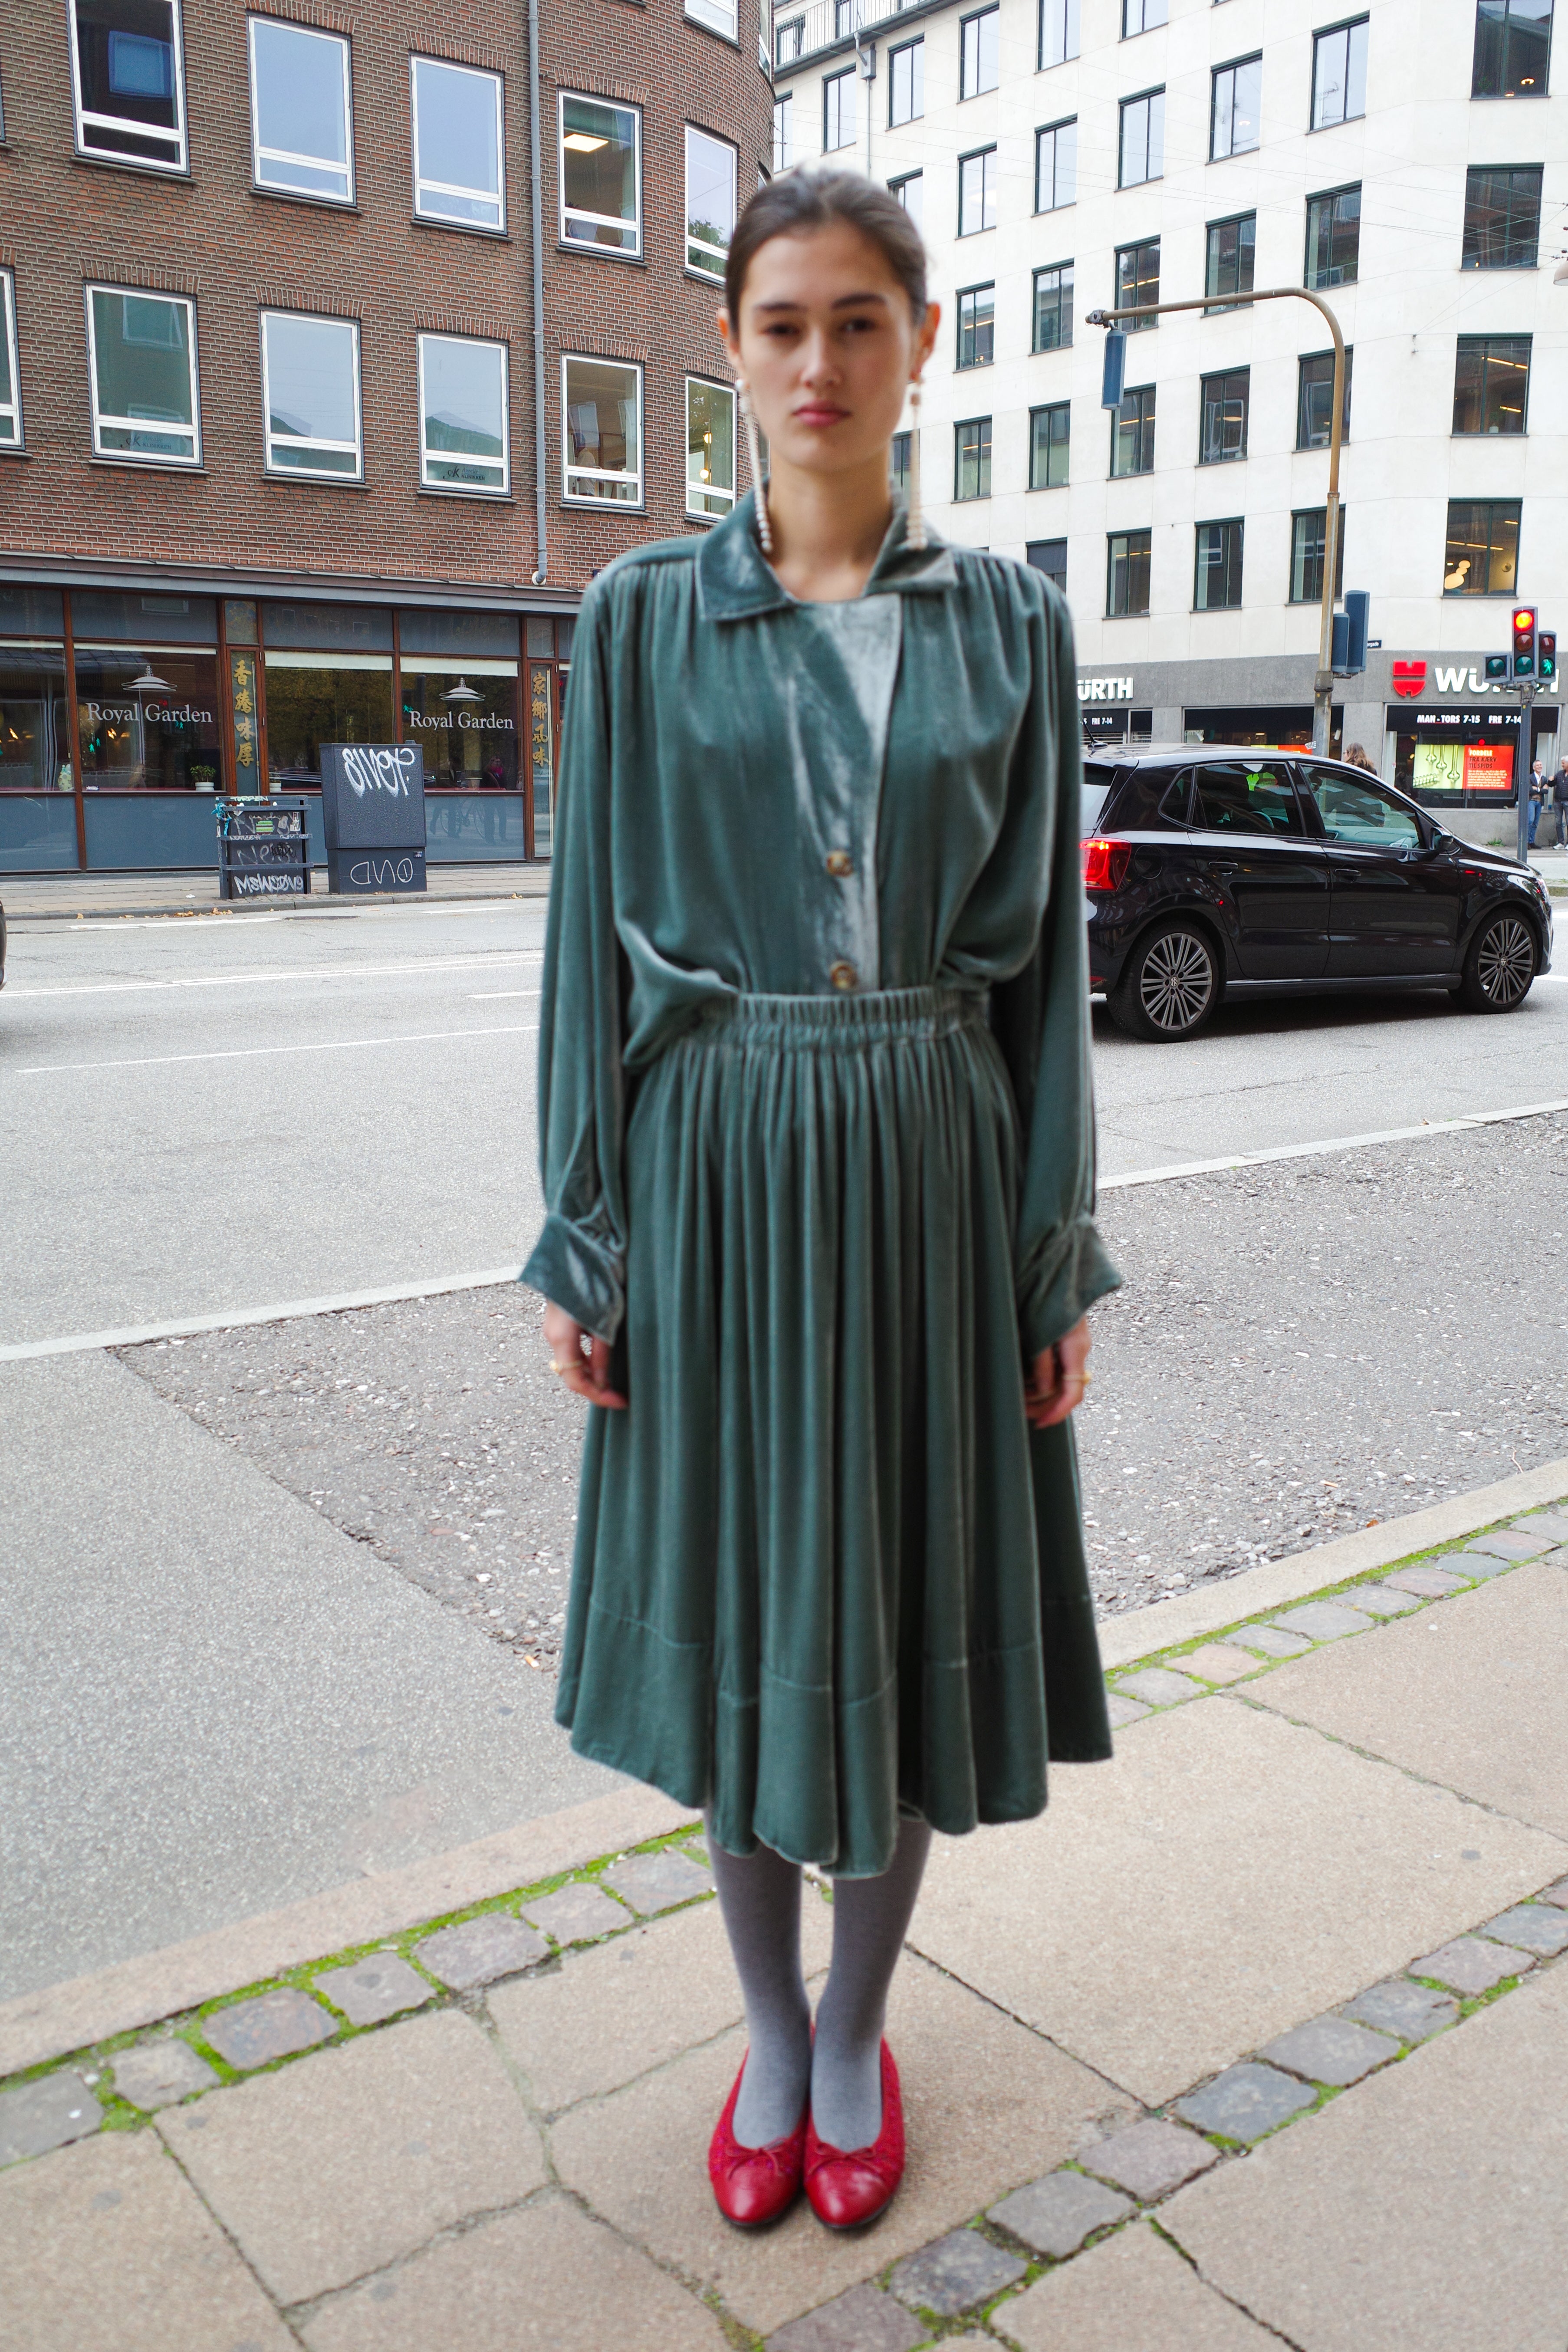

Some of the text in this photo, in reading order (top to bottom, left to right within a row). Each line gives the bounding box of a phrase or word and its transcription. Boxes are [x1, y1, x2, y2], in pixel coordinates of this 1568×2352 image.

[1077, 677, 1134, 701] ÜRTH
[85, 703, 214, 724] Royal Garden
[409, 711, 514, 730] Royal Garden
[1417, 715, 1436, 724] MAN
[1441, 715, 1460, 724] TORS
[1463, 715, 1480, 724] 7-15
[1489, 715, 1502, 724] FRE
[293, 812, 299, 821] PU
[293, 822, 299, 831] PU
